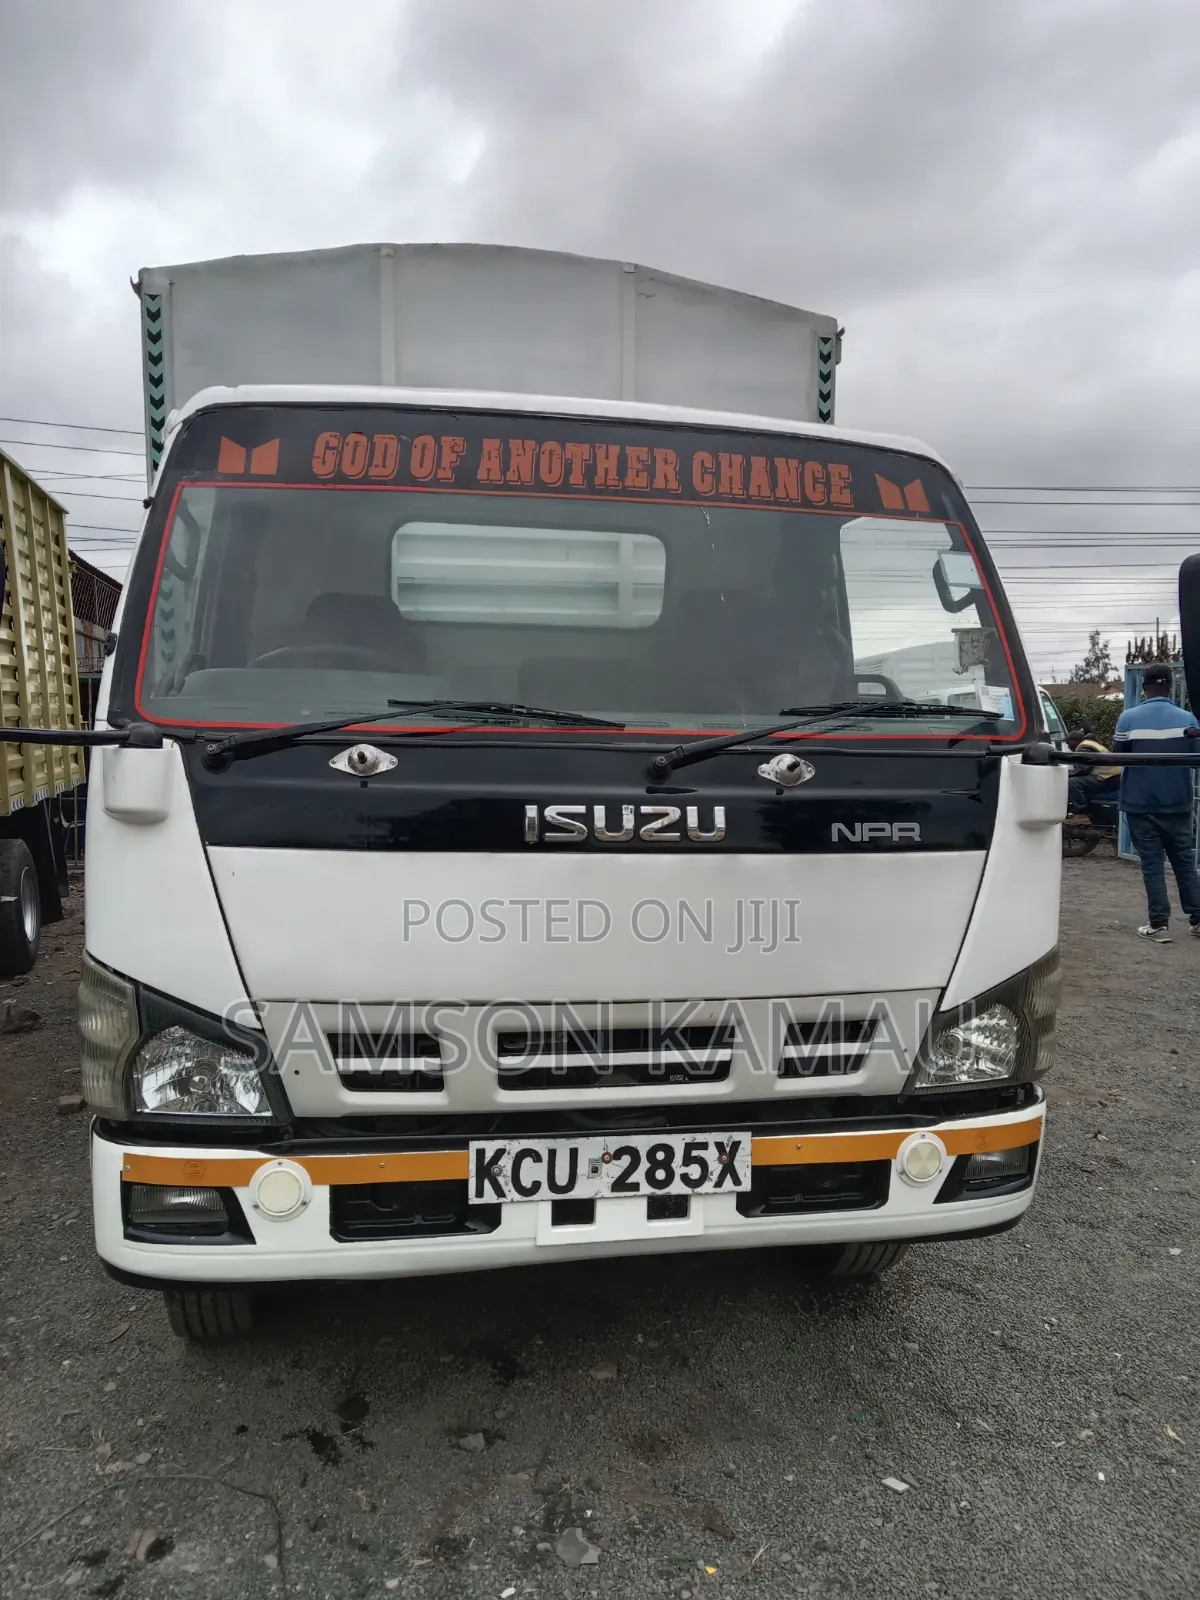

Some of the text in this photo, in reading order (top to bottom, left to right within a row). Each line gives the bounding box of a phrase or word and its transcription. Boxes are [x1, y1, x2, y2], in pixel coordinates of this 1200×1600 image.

[312, 431, 854, 508] GOD OF ANOTHER CHANCE
[524, 805, 727, 844] ISUZU
[831, 822, 922, 843] NPR
[475, 1140, 743, 1199] KCU 285X
